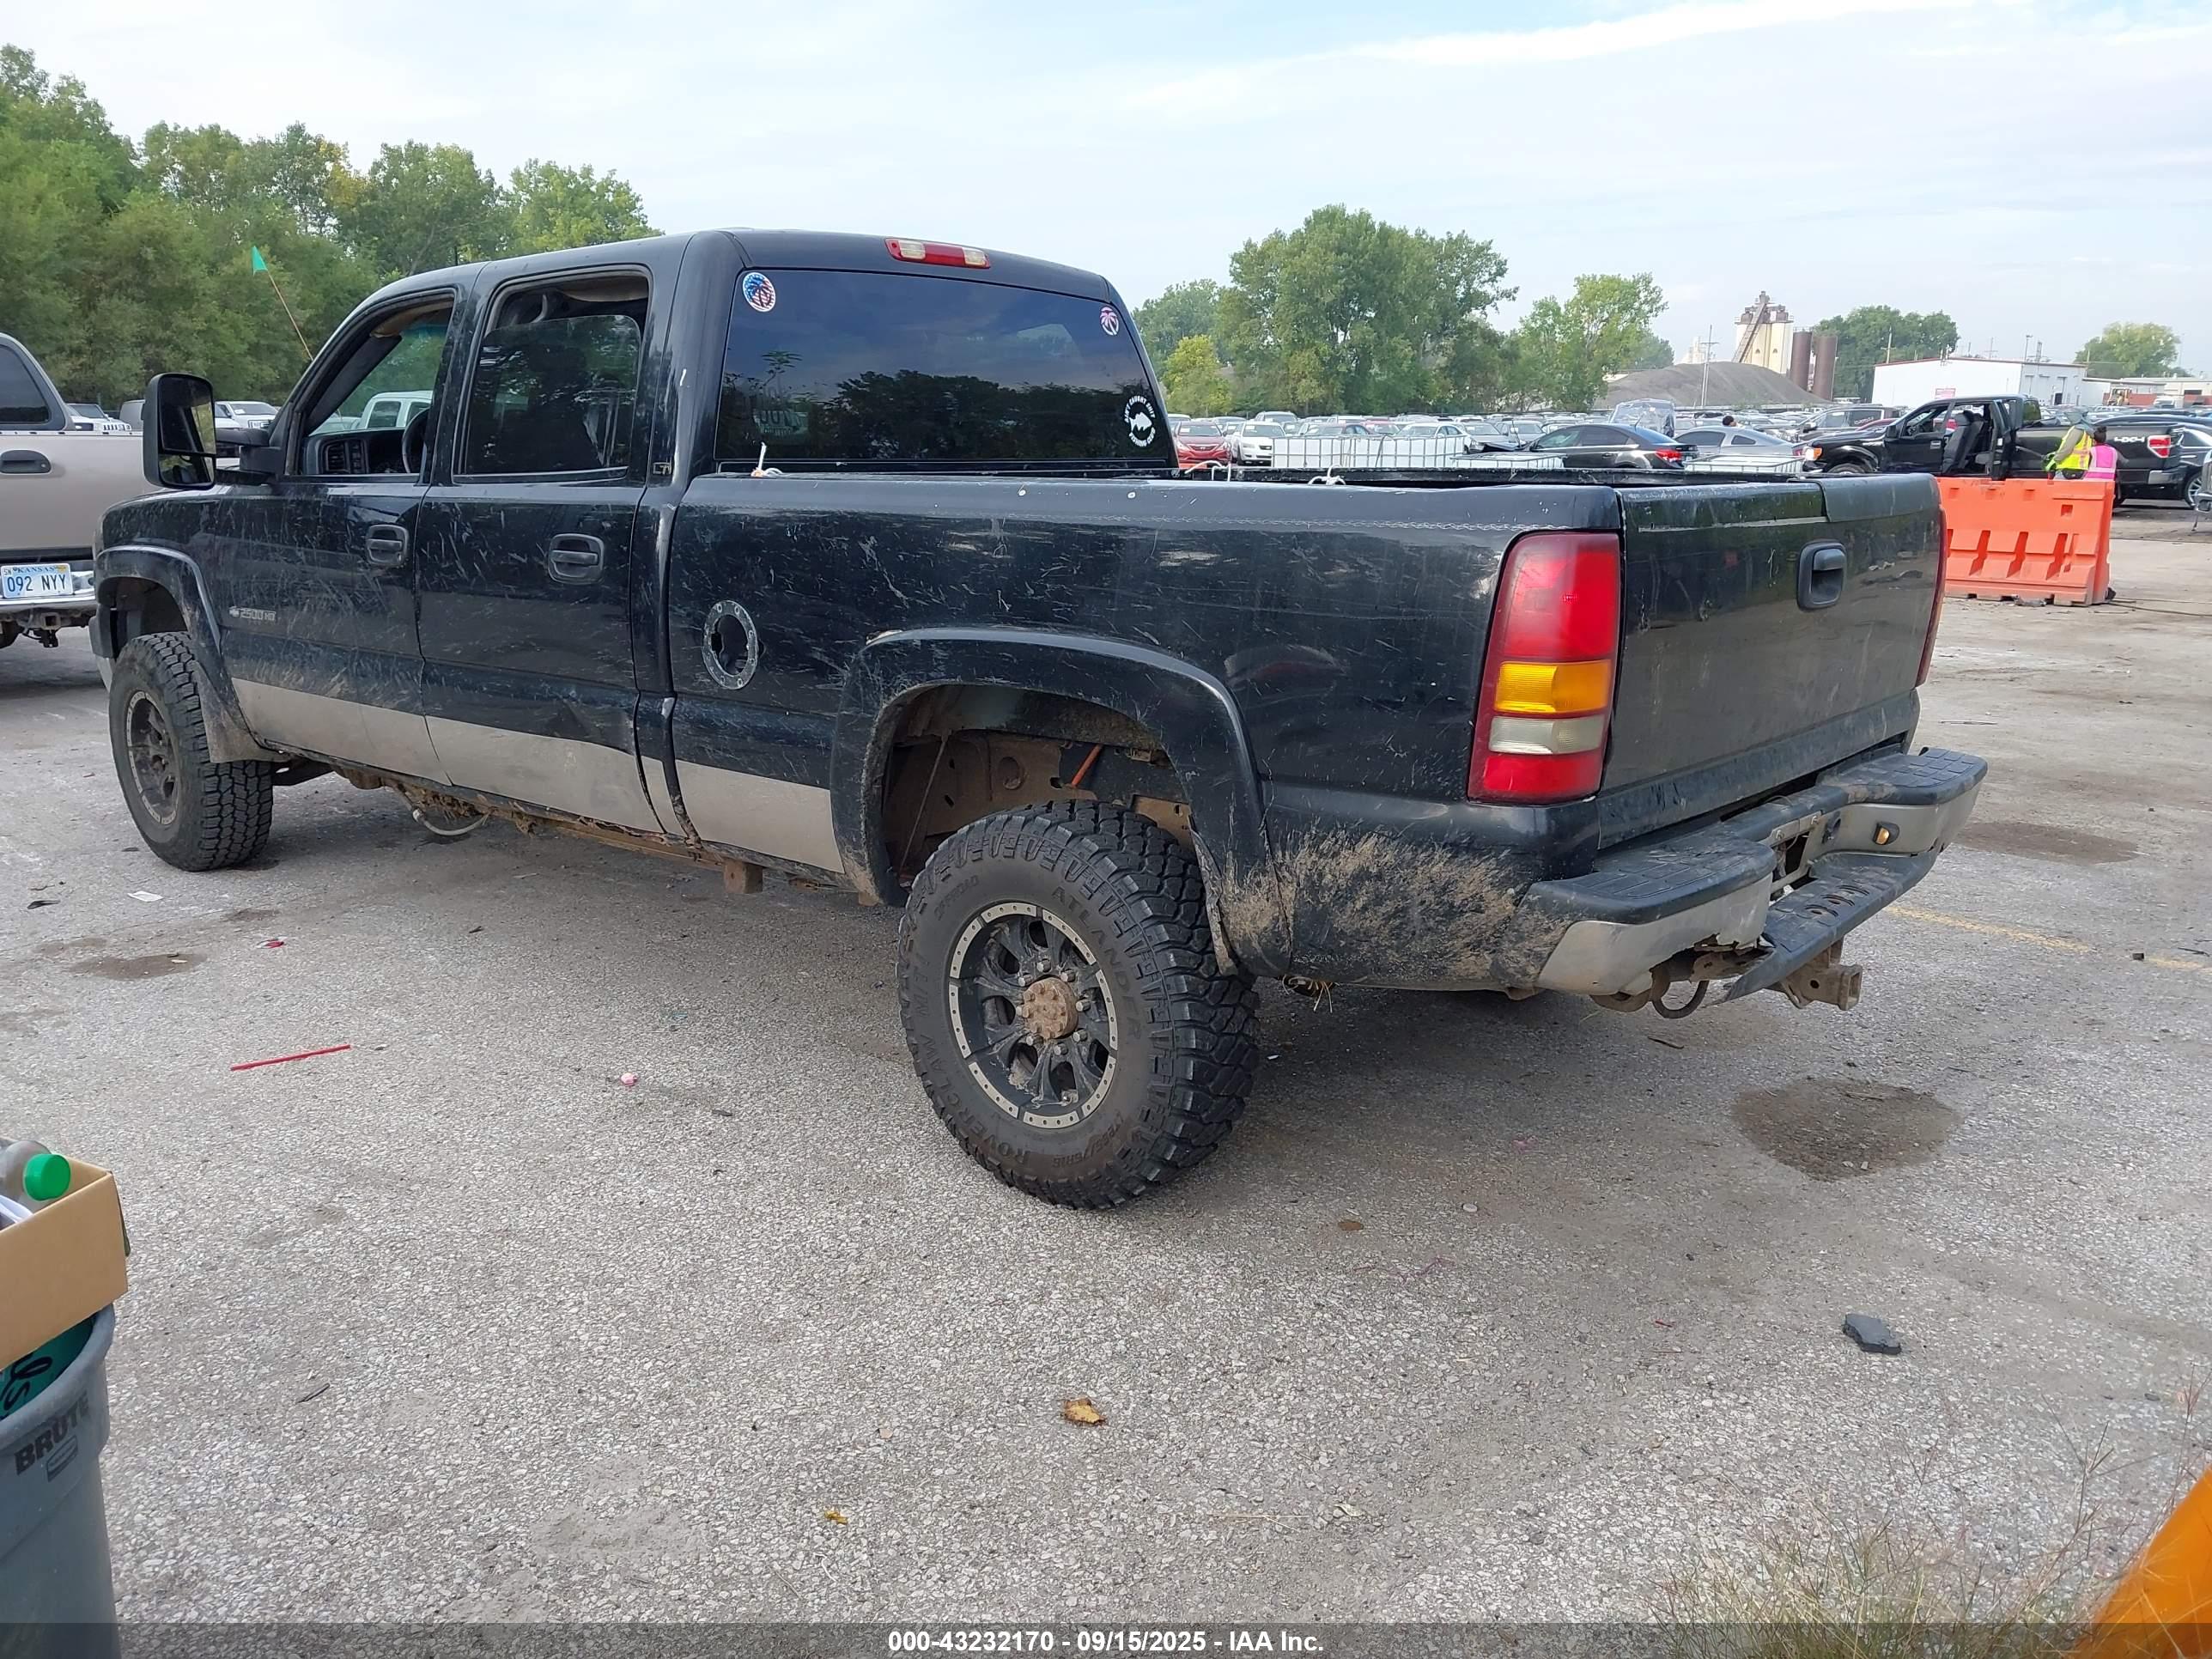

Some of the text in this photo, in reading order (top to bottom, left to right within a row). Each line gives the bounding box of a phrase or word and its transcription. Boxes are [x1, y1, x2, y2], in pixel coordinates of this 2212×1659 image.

[7, 574, 66, 592] 092 NYY
[1053, 885, 1141, 1039] ATLANDER
[13, 1389, 90, 1476] BRUTE
